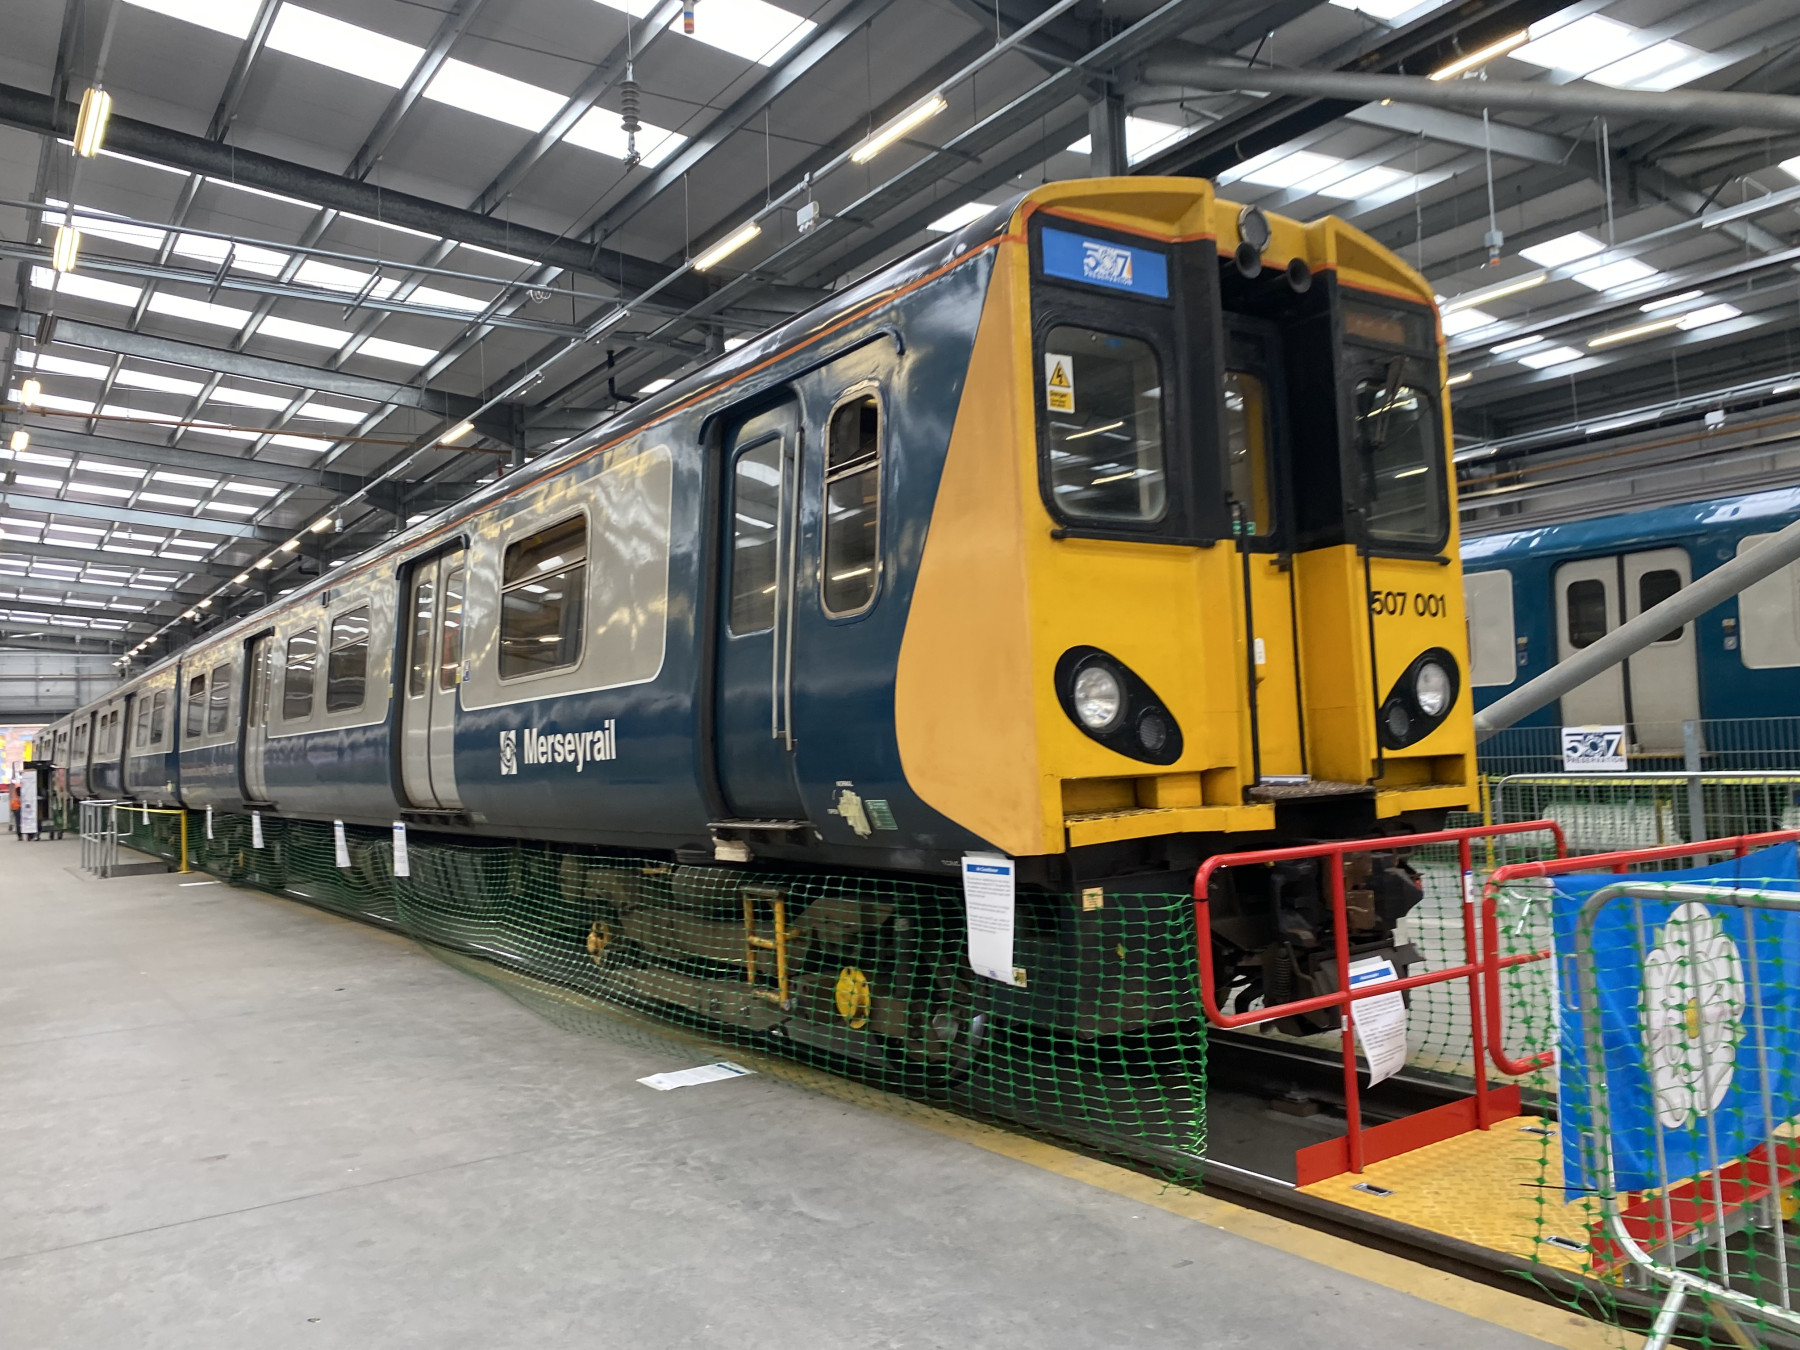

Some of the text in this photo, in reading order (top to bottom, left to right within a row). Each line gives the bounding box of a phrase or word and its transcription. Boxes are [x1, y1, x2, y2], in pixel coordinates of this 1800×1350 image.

[1083, 241, 1132, 279] 507
[1083, 270, 1133, 286] PRESERVATION
[1370, 591, 1446, 618] 507 001
[524, 719, 616, 773] Merseyrail
[1565, 731, 1622, 757] 507
